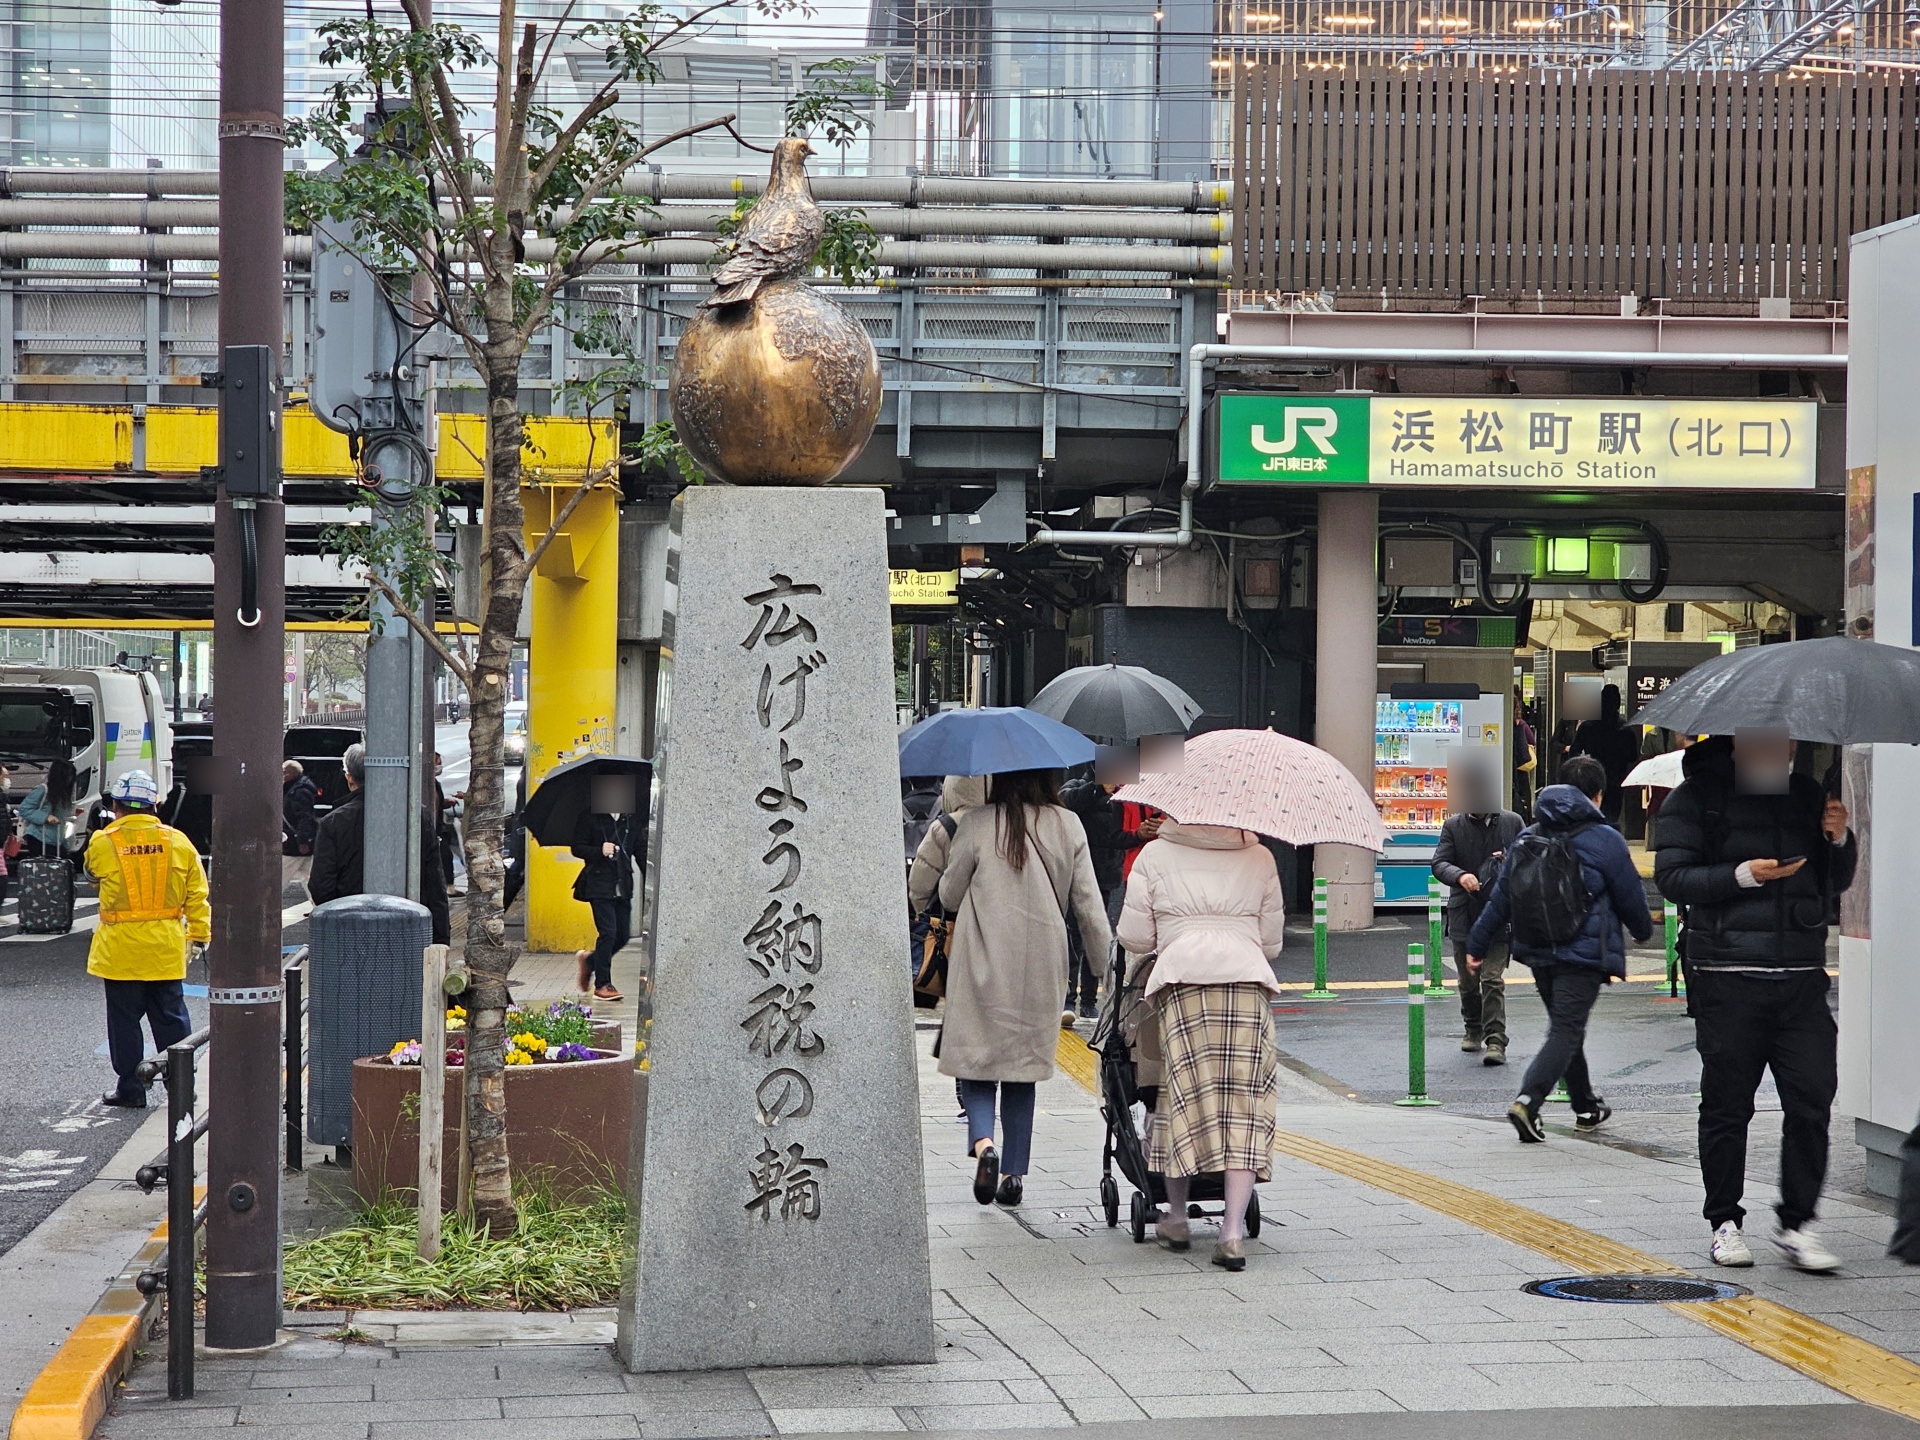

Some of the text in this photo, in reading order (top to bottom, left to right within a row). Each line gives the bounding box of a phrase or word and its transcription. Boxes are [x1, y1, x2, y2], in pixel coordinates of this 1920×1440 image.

[1251, 406, 1339, 455] JR
[1262, 457, 1328, 471] JR東日本
[1390, 459, 1656, 479] Hamamatsuchō Station
[1402, 636, 1437, 645] NewDays
[740, 573, 828, 1222] 広げよう納税の輪
